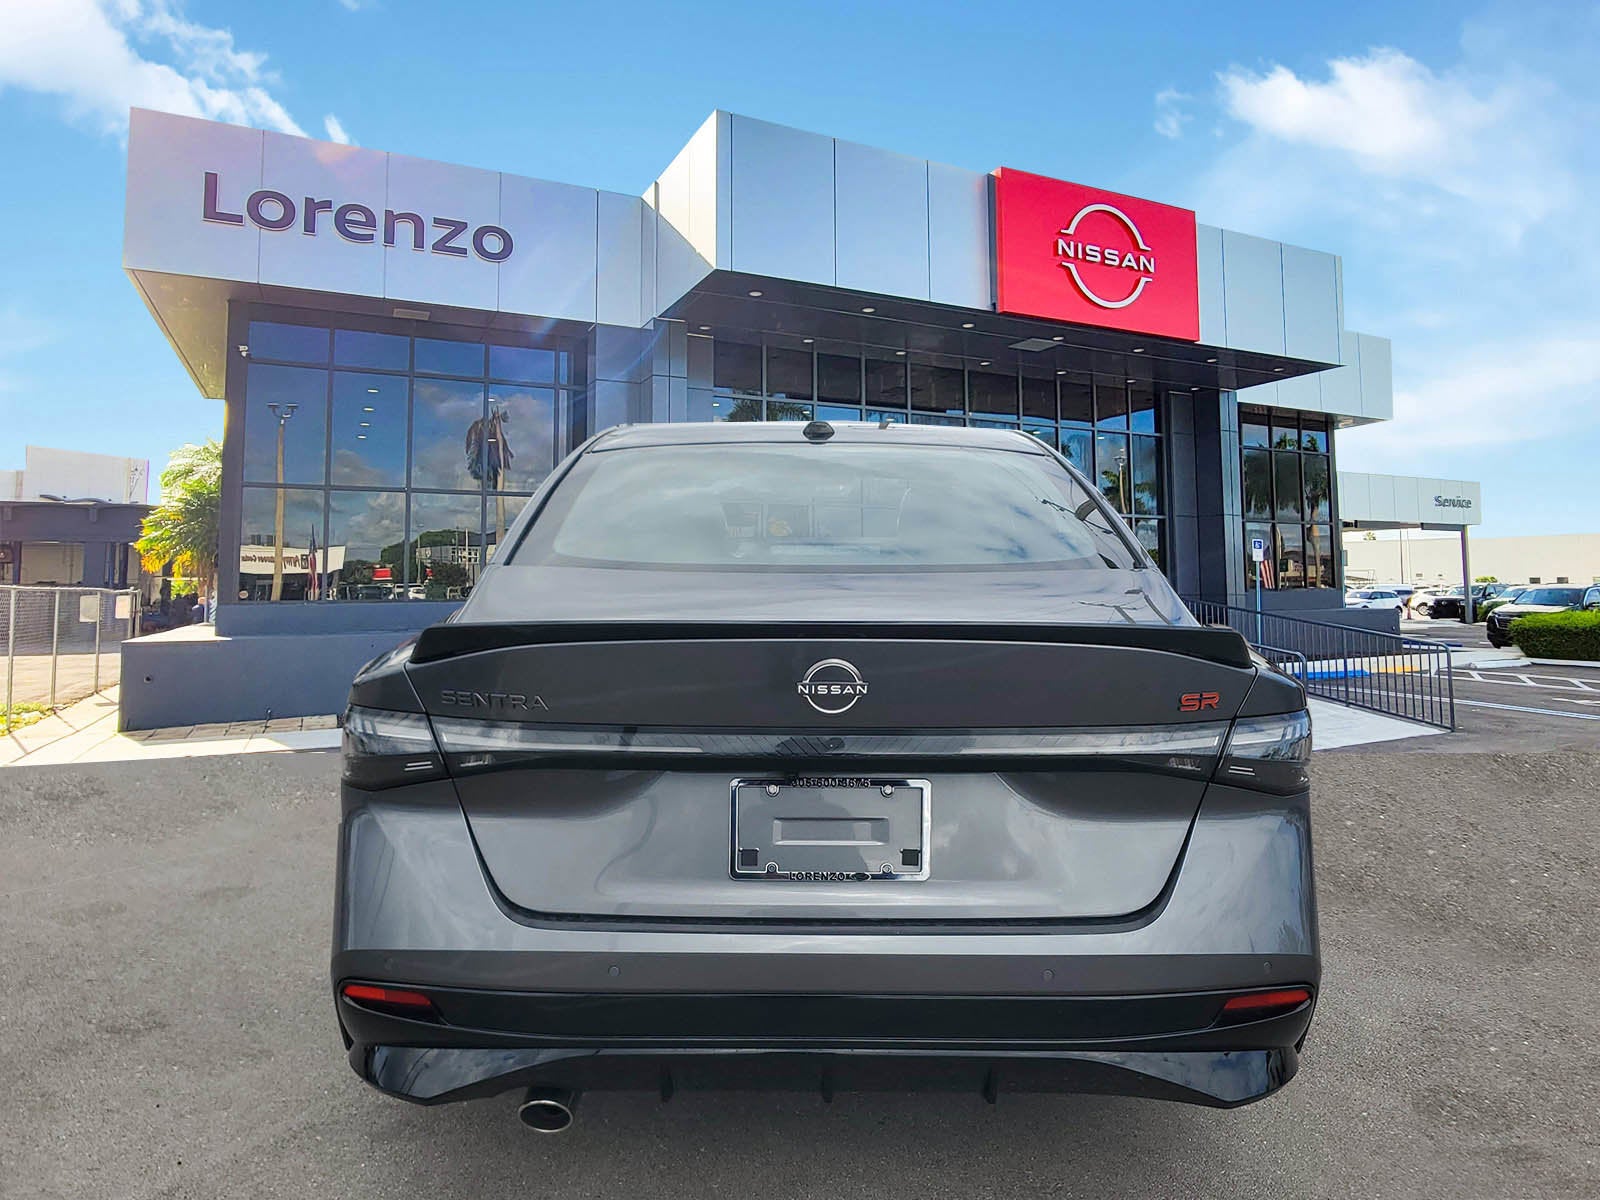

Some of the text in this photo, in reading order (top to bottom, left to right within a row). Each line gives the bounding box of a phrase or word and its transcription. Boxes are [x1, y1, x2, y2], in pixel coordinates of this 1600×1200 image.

[202, 171, 514, 262] Lorenzo
[1057, 238, 1155, 273] NISSAN
[1433, 495, 1472, 509] Service
[797, 685, 868, 695] NISSAN
[441, 690, 550, 711] SENTRA
[1180, 692, 1219, 711] SR
[789, 871, 846, 881] LORENZO
